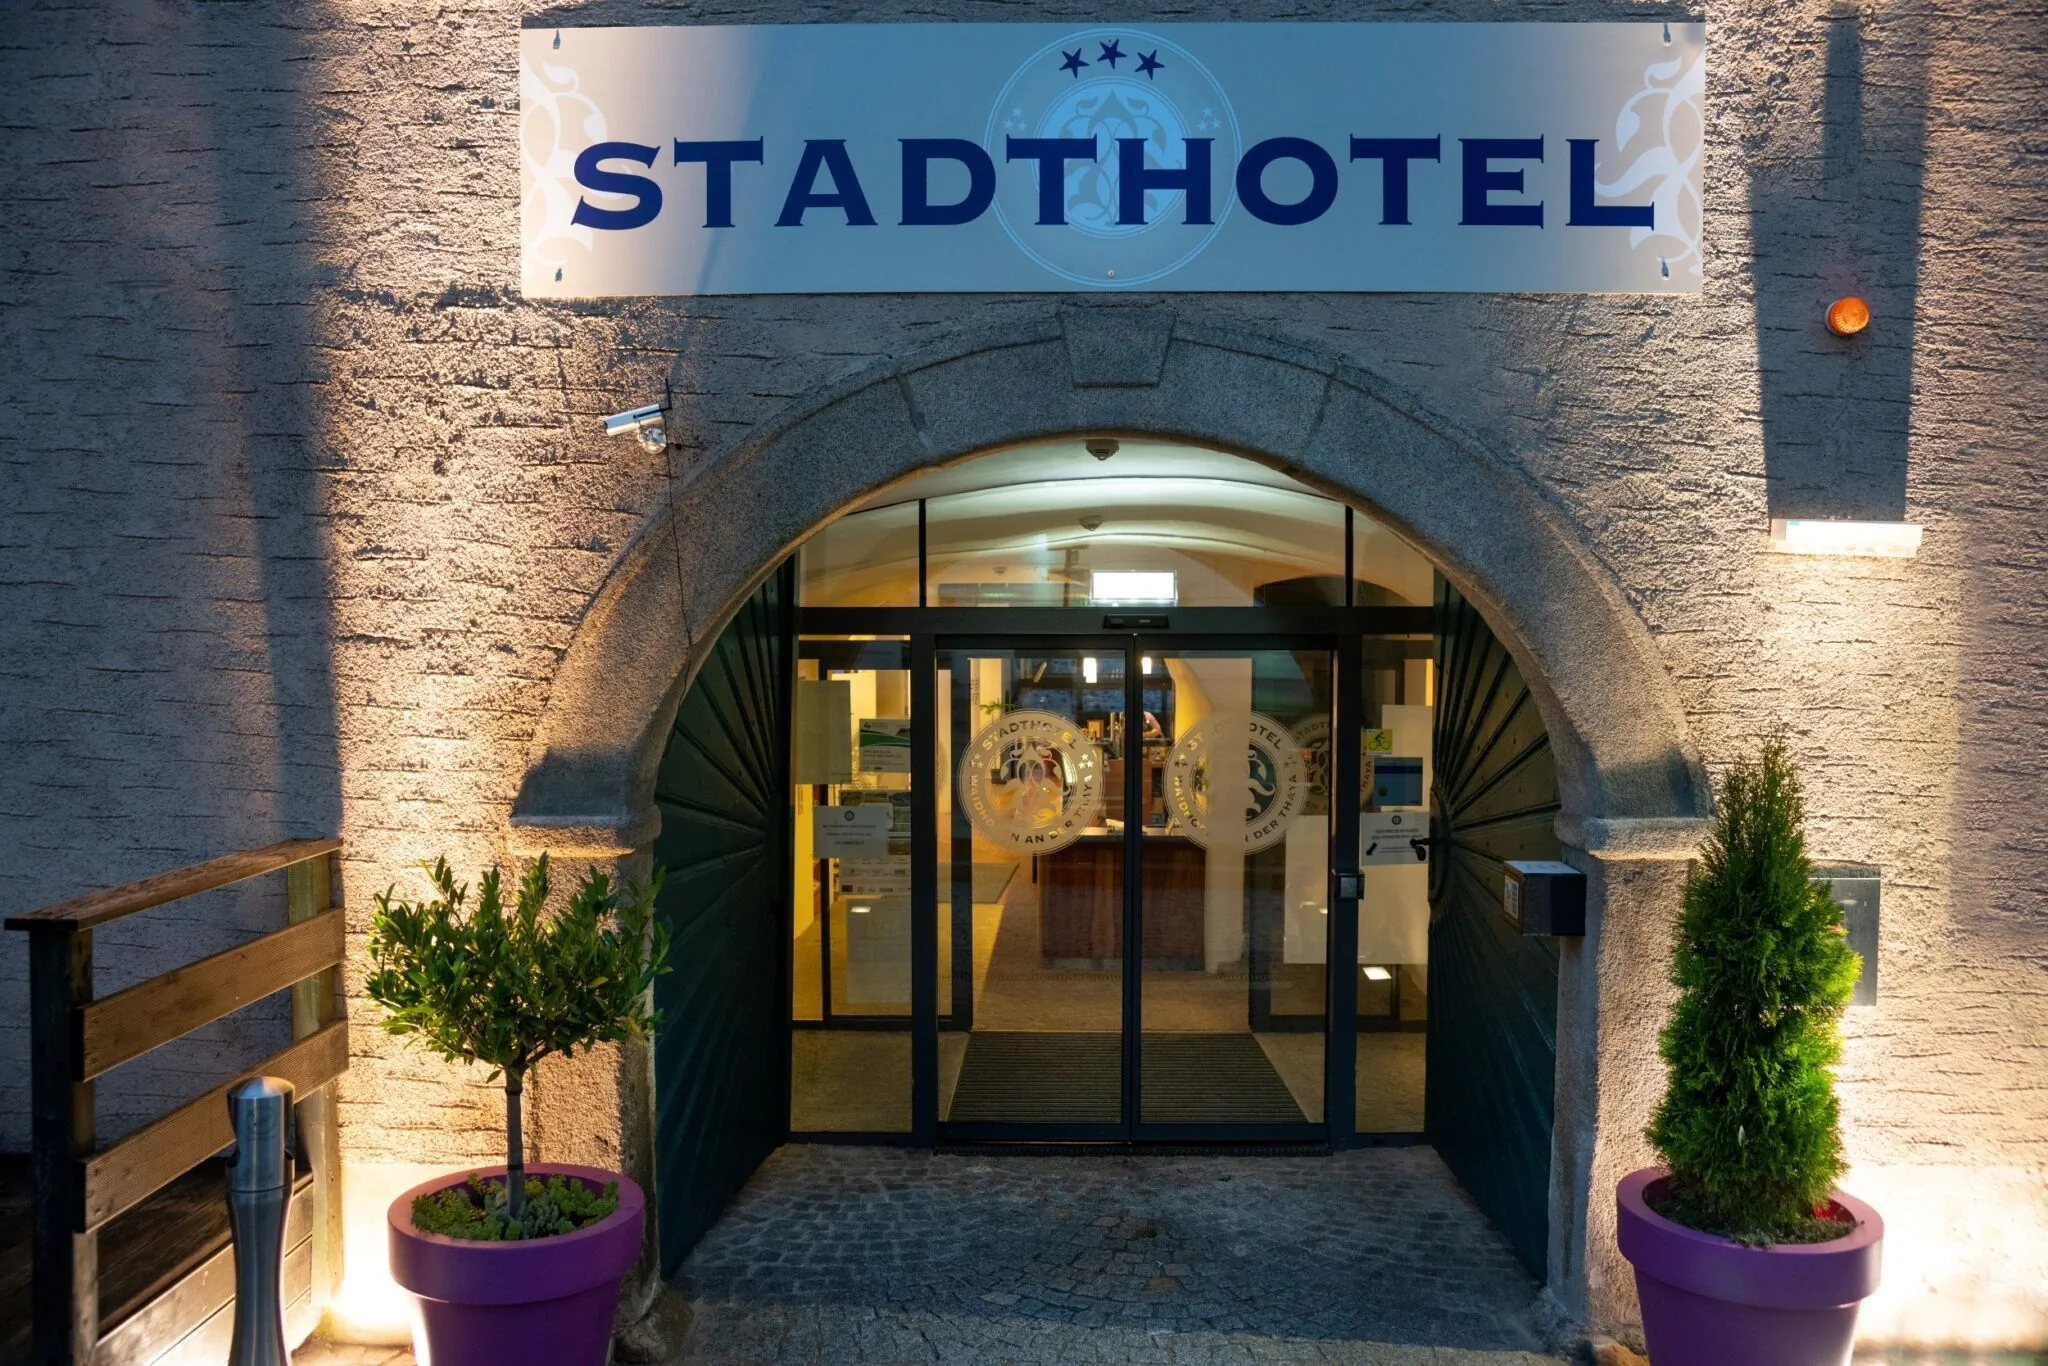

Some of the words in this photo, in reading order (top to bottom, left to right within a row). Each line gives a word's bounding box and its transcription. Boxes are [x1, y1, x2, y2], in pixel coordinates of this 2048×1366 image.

[571, 134, 1655, 230] STADTHOTEL
[982, 720, 1077, 750] STADTHOTEL
[1187, 722, 1282, 751] STOTEL
[968, 774, 1019, 842] WAIDHON
[1025, 834, 1044, 844] AN
[1048, 820, 1073, 840] DER
[1253, 820, 1279, 839] DER
[1278, 774, 1297, 817] THAYA
